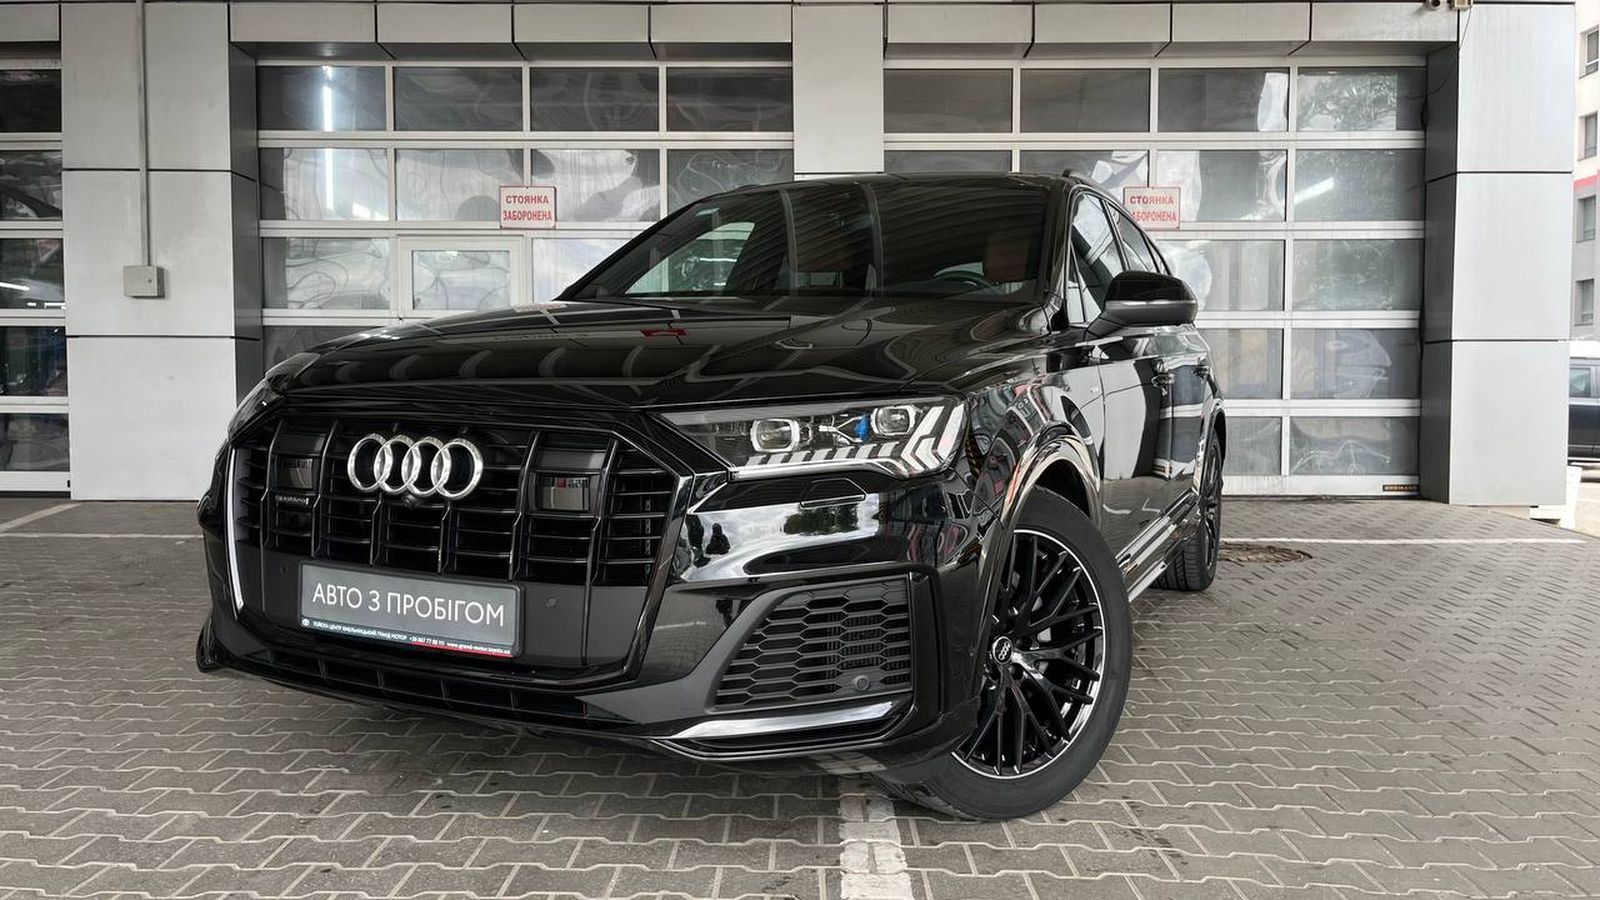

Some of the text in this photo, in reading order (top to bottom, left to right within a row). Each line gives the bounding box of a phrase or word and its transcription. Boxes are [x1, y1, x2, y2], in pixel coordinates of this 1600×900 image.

[505, 195, 549, 204] СТОЯНКА
[1130, 196, 1174, 204] СТОЯНКА
[503, 210, 552, 221] ЗАБОРОНЕНА
[1131, 211, 1177, 221] АБОРОНЕНА
[312, 583, 505, 627] АВТО З ПРОБІГОМ
